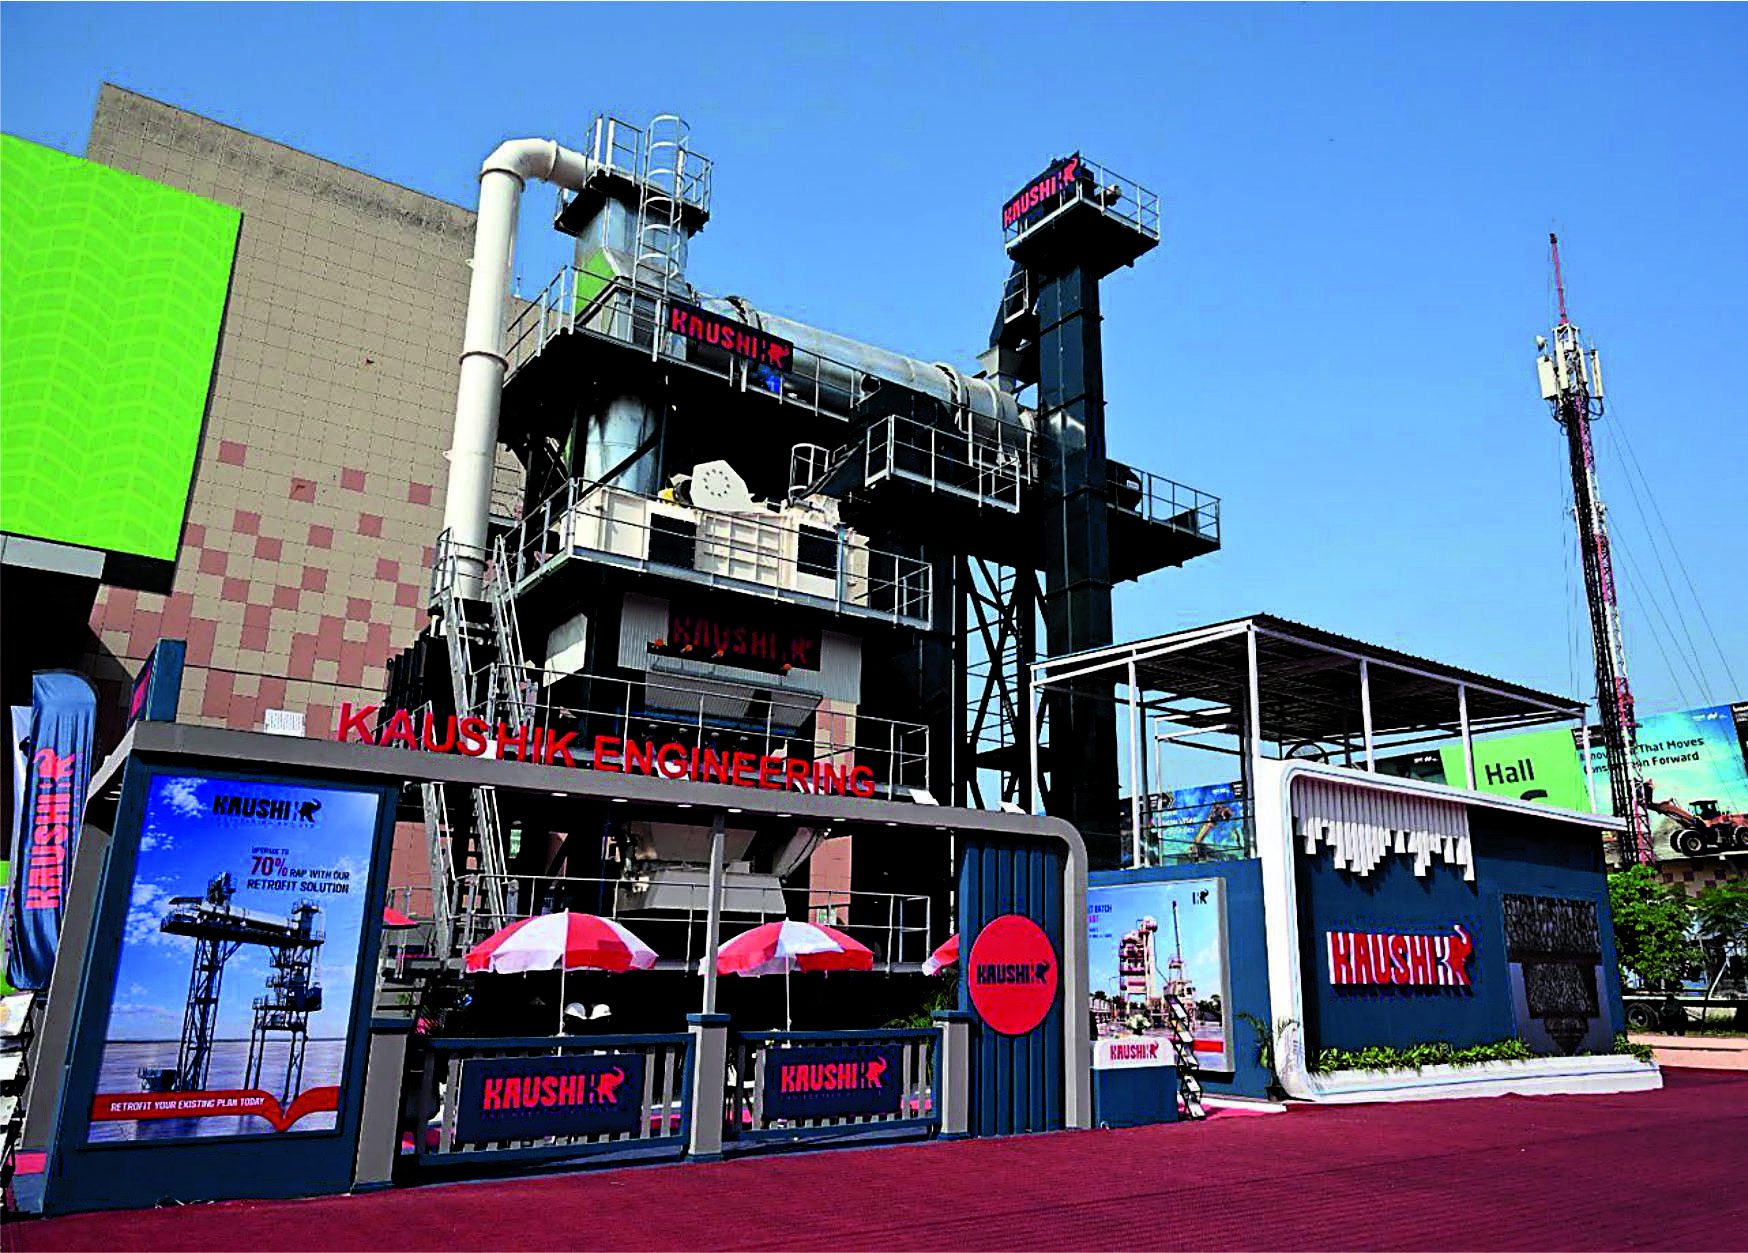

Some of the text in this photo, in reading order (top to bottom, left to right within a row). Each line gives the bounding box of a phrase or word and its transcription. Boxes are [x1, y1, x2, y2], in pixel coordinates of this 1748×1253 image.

[338, 701, 875, 798] KAUSHIK ENGINEERING
[1638, 742, 1663, 754] That
[1666, 737, 1704, 750] Moves
[1652, 751, 1700, 766] Forward
[1484, 758, 1535, 785] Hall
[251, 856, 350, 880] 70% RAP WITH OUR
[247, 878, 350, 894] RETROFIT SOLUTION
[1326, 924, 1473, 986] KAUSHIK
[110, 1097, 265, 1112] RETROFIT YOUR EXISTING PLAN TODAY
